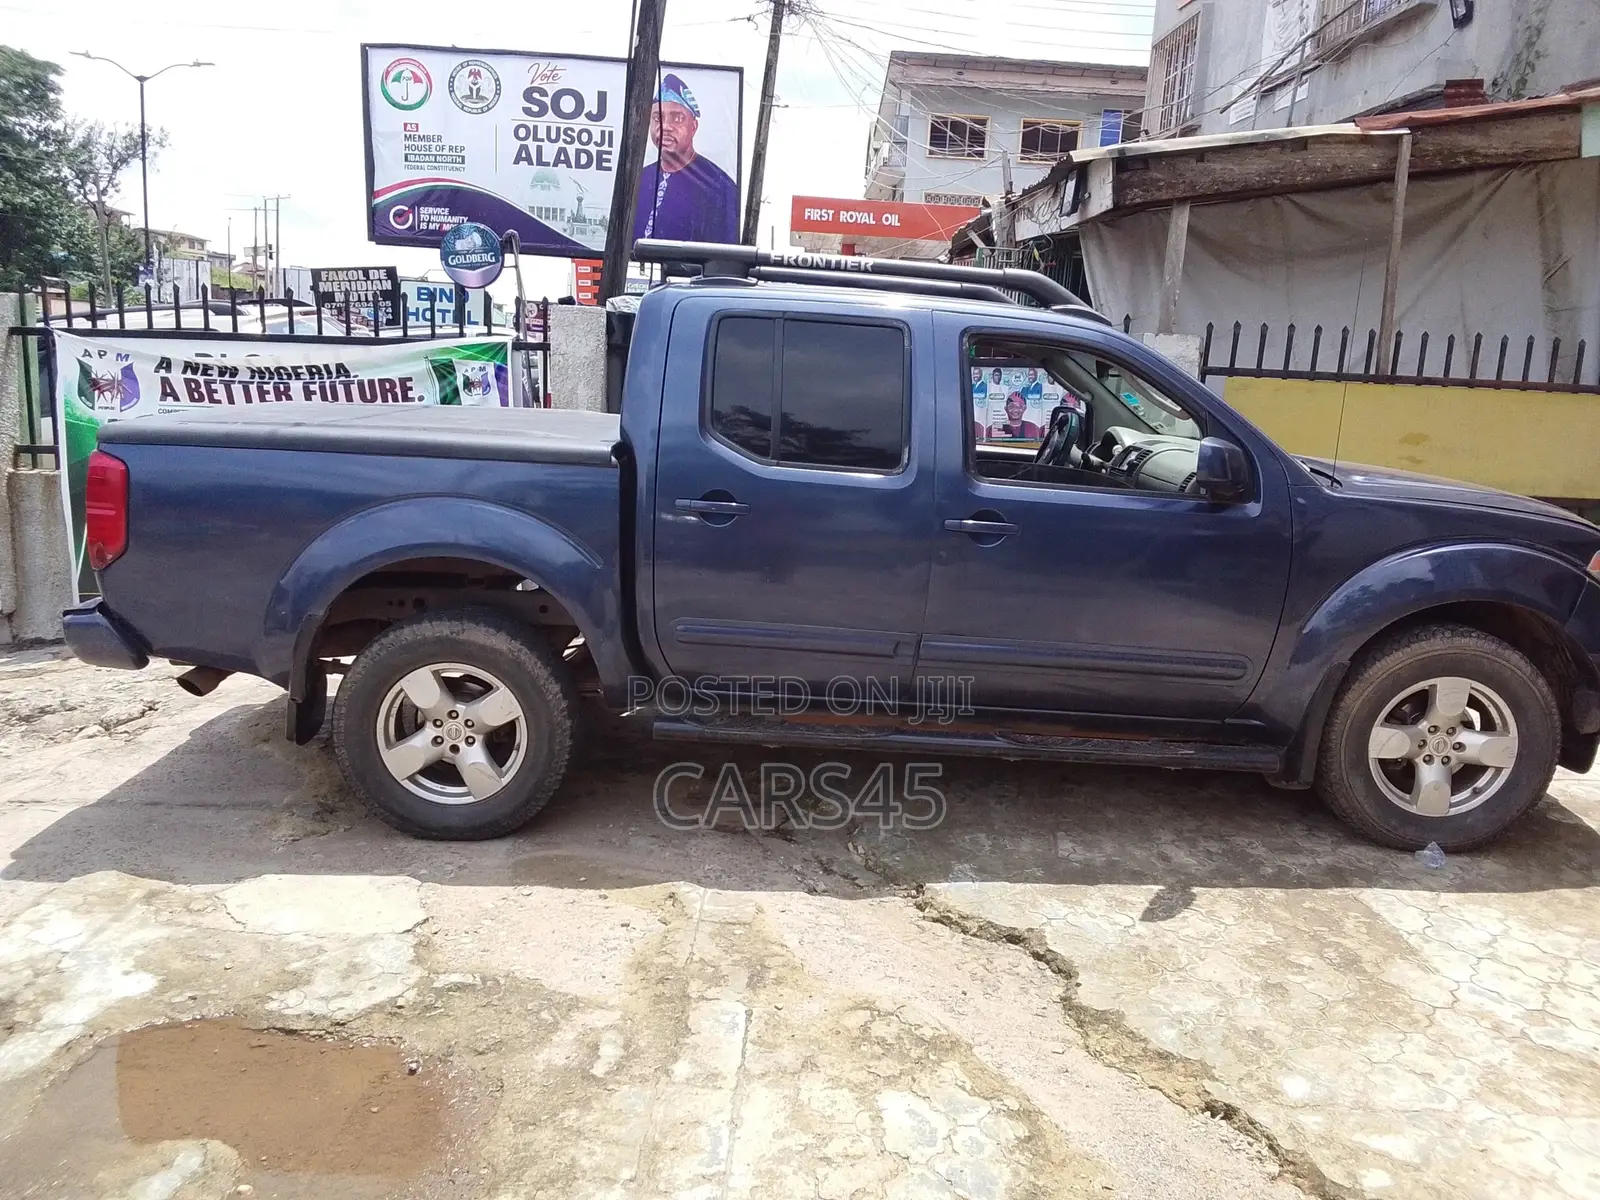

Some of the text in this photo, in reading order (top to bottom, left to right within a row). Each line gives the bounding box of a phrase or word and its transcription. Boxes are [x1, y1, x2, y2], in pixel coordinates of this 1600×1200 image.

[528, 61, 567, 85] Vote
[522, 86, 608, 122] SOJ
[405, 123, 417, 132] AS
[404, 133, 442, 143] MEMBER
[513, 123, 614, 148] OLUSOJI
[404, 144, 466, 154] HOUSE OF REP
[407, 154, 462, 164] IBADAN NORTH
[512, 143, 613, 172] ALADE
[404, 163, 466, 173] FEDERAL CONSTITUENCY
[419, 206, 450, 215] SERVICE
[804, 207, 901, 227] FIRST ROYAL OIL
[420, 214, 469, 224] TO HUMANITY
[420, 222, 428, 230] IS
[428, 222, 440, 231] MY
[448, 252, 496, 266] GOLDBERG
[770, 253, 874, 272] FRONTIER
[320, 269, 388, 282] FAKOL DE
[318, 280, 392, 292] MERIDIAN
[153, 356, 359, 381] A NEW NIGERIA.
[159, 376, 425, 405] A BETTER FUTURE.
